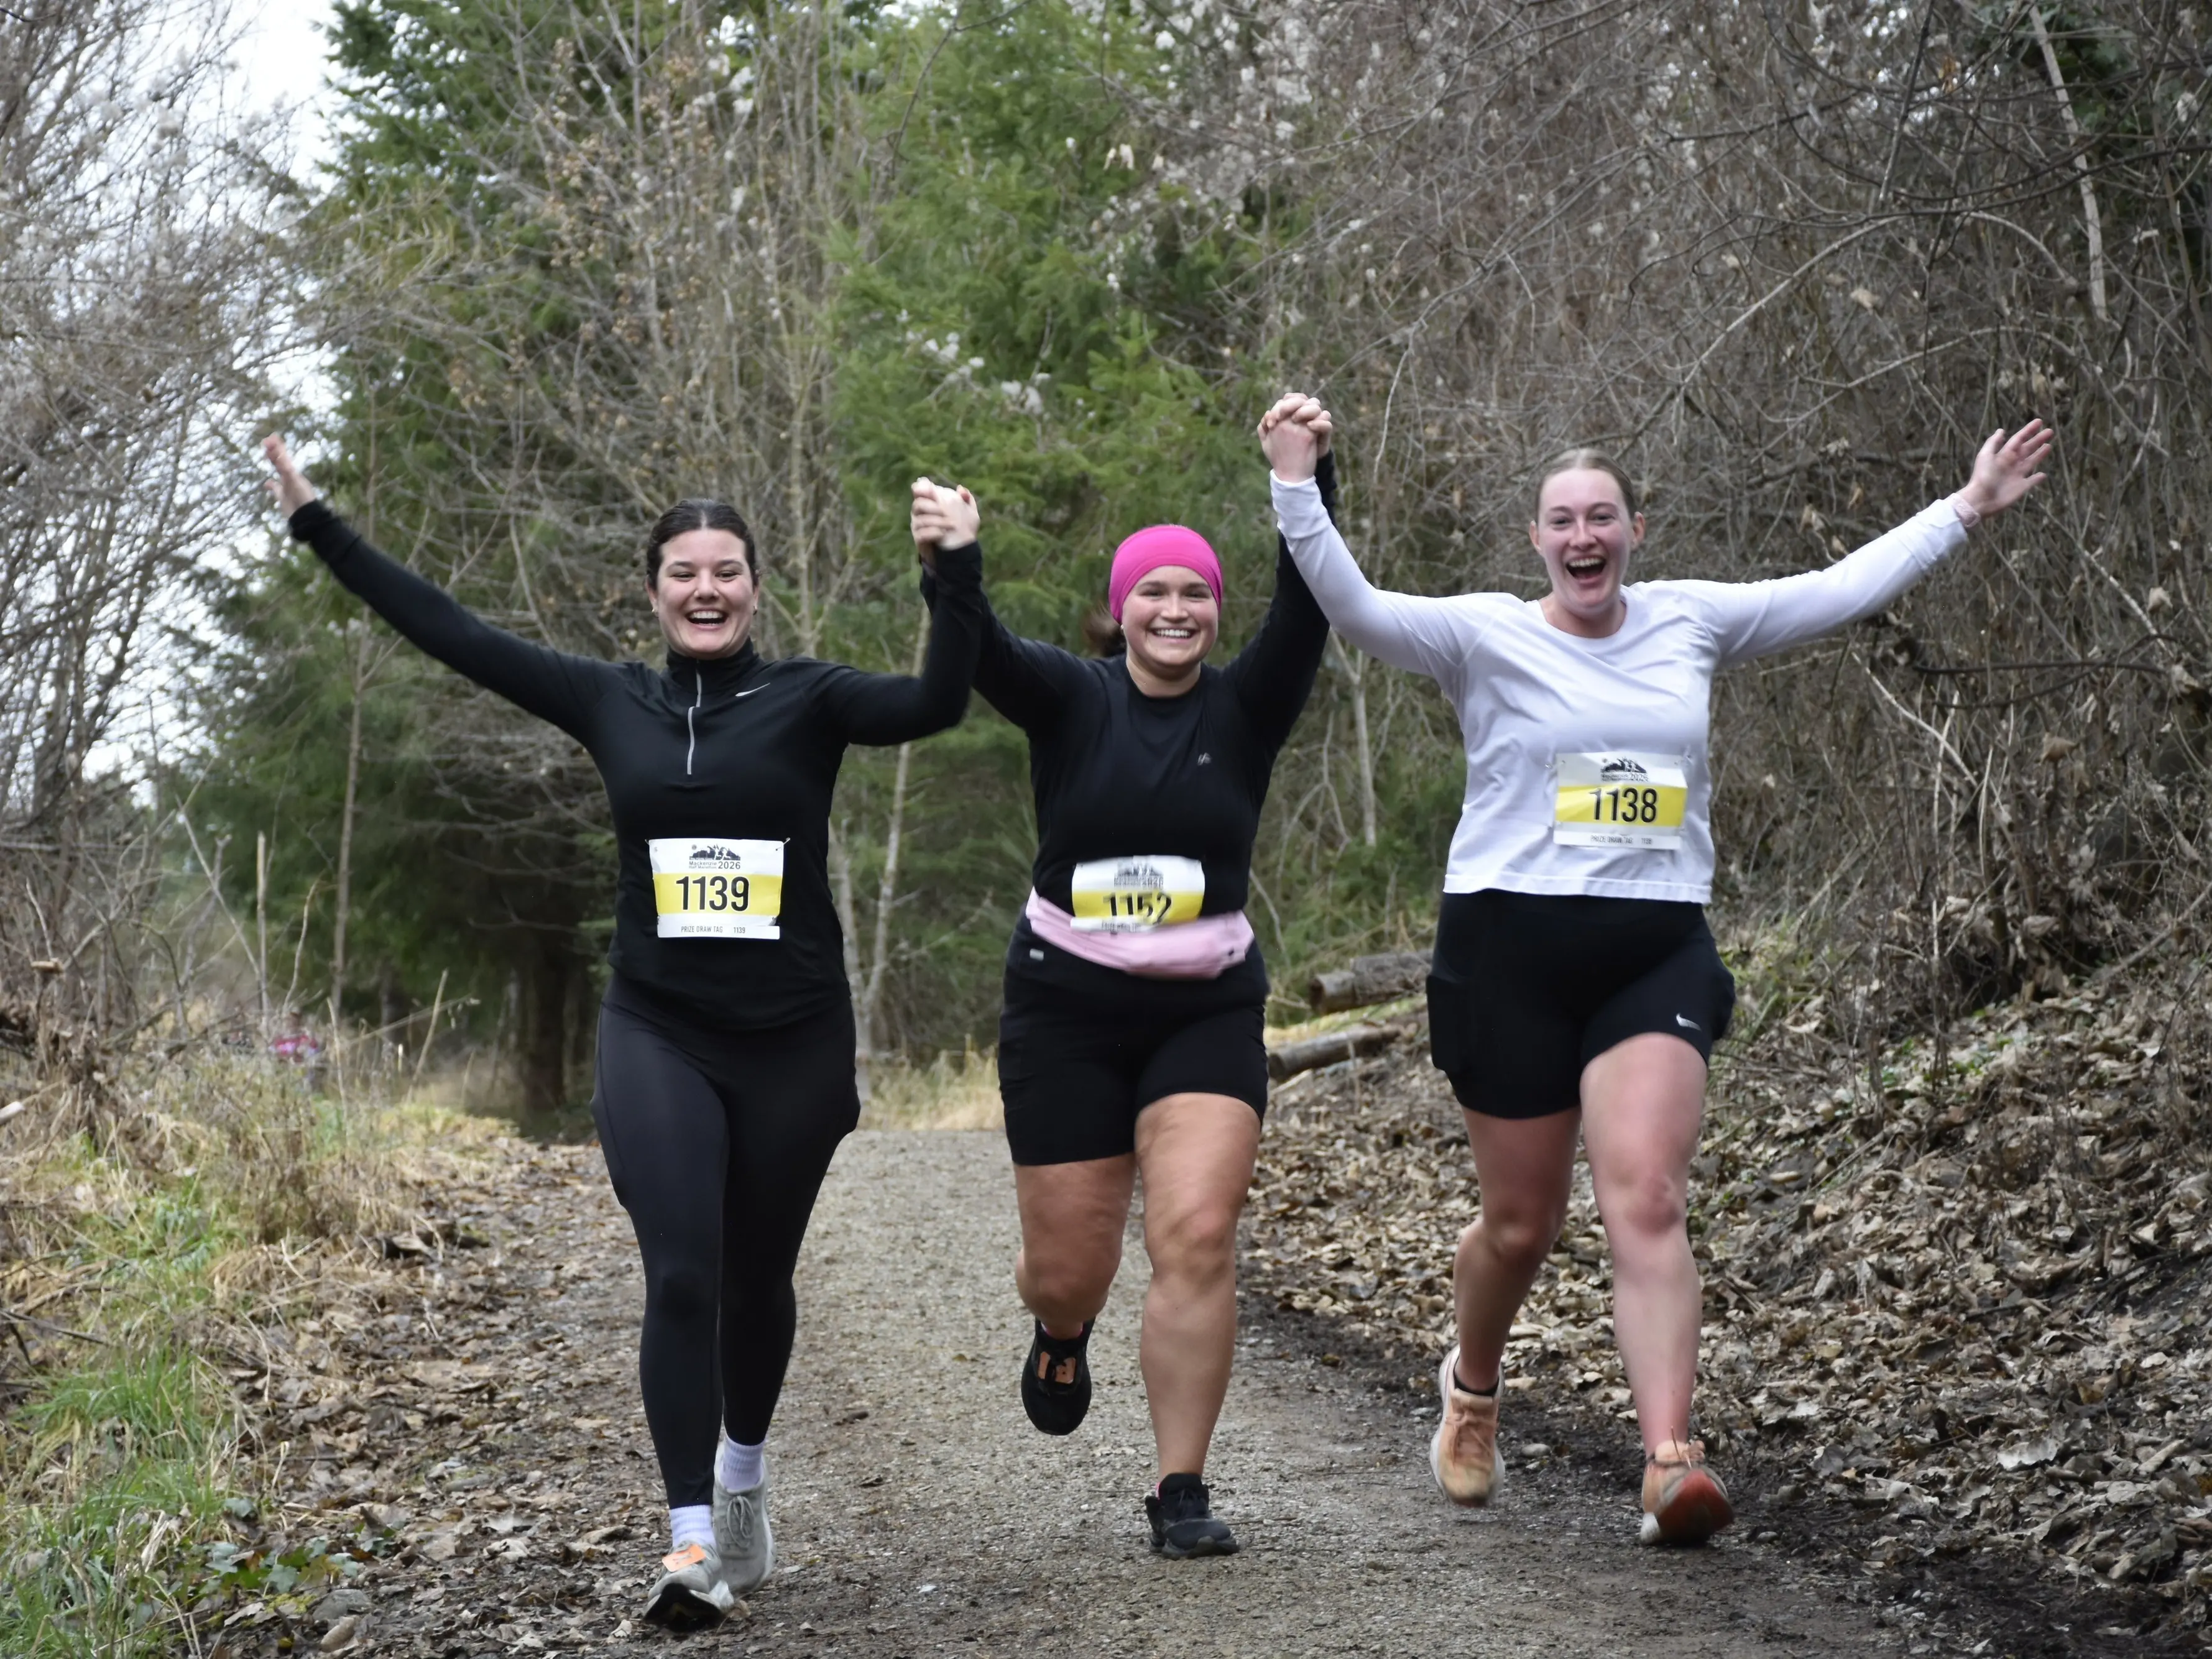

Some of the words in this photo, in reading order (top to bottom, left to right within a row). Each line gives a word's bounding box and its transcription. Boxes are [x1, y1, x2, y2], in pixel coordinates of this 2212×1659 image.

[1590, 788, 1657, 822] 1138
[718, 861, 740, 870] 2026
[676, 876, 749, 912] 1139
[1103, 893, 1171, 925] 1152
